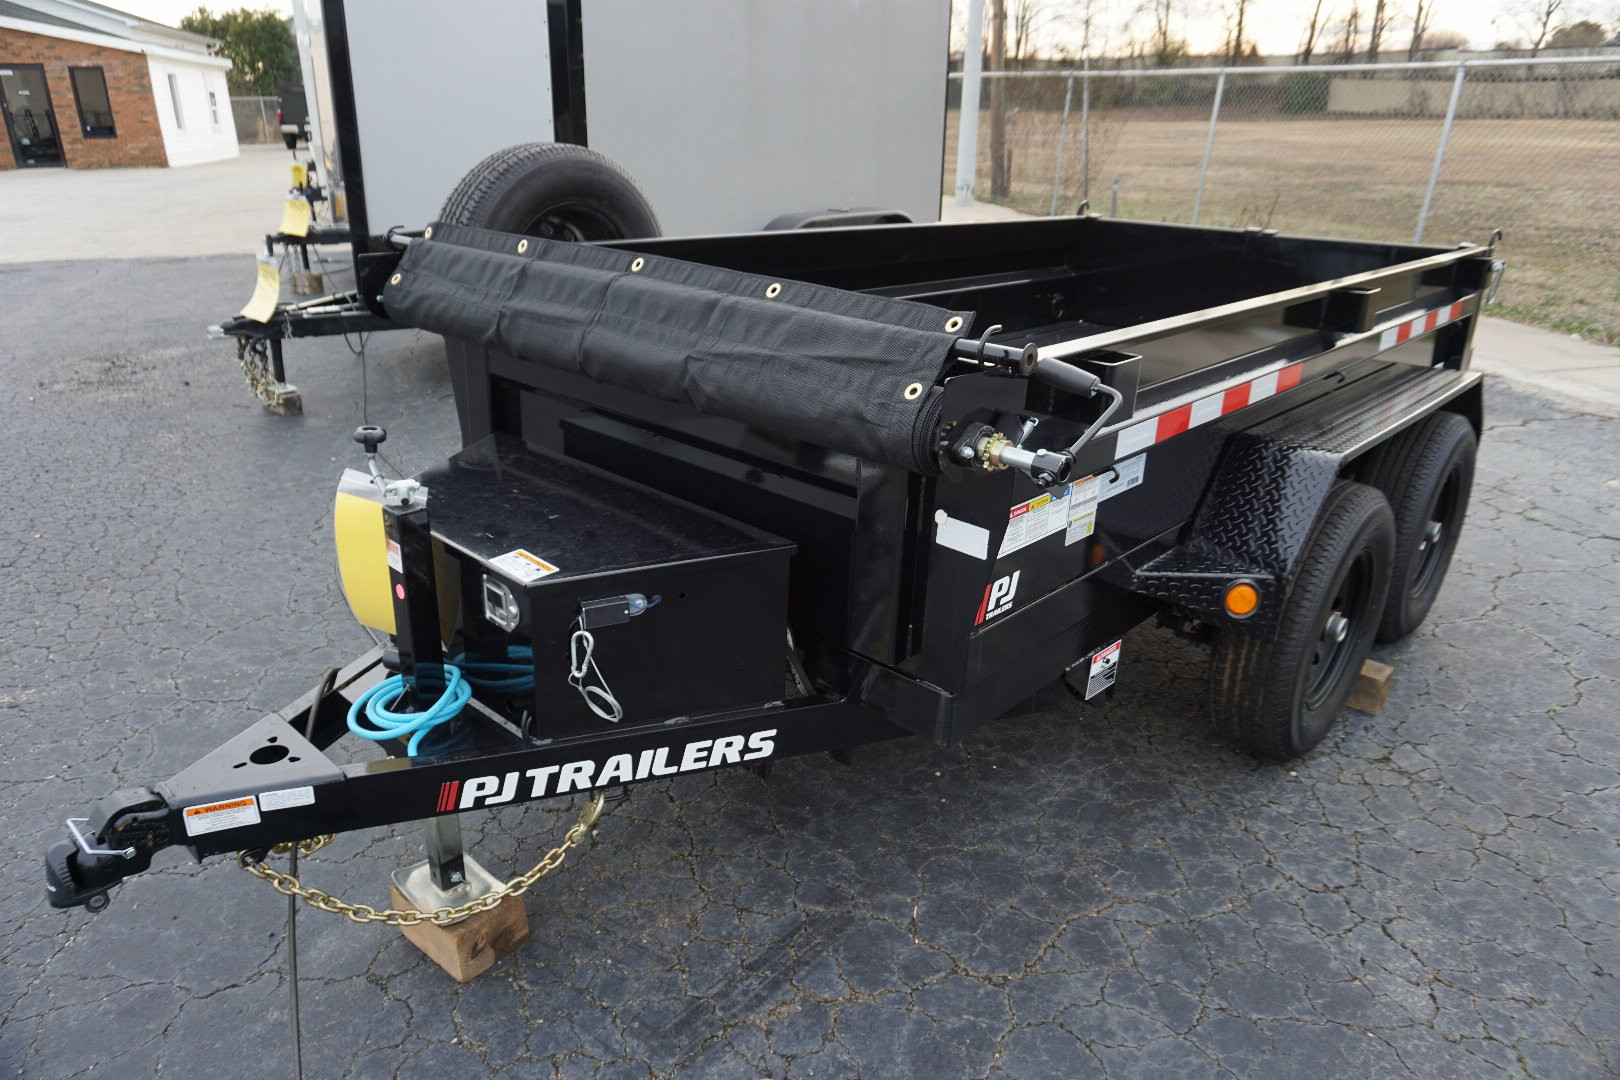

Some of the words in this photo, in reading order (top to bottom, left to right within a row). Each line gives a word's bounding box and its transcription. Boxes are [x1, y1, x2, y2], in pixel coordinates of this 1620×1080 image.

[987, 570, 1020, 611] PJ
[459, 772, 519, 809] PJ
[526, 729, 777, 797] TRAILERS
[205, 800, 247, 813] WARNING
